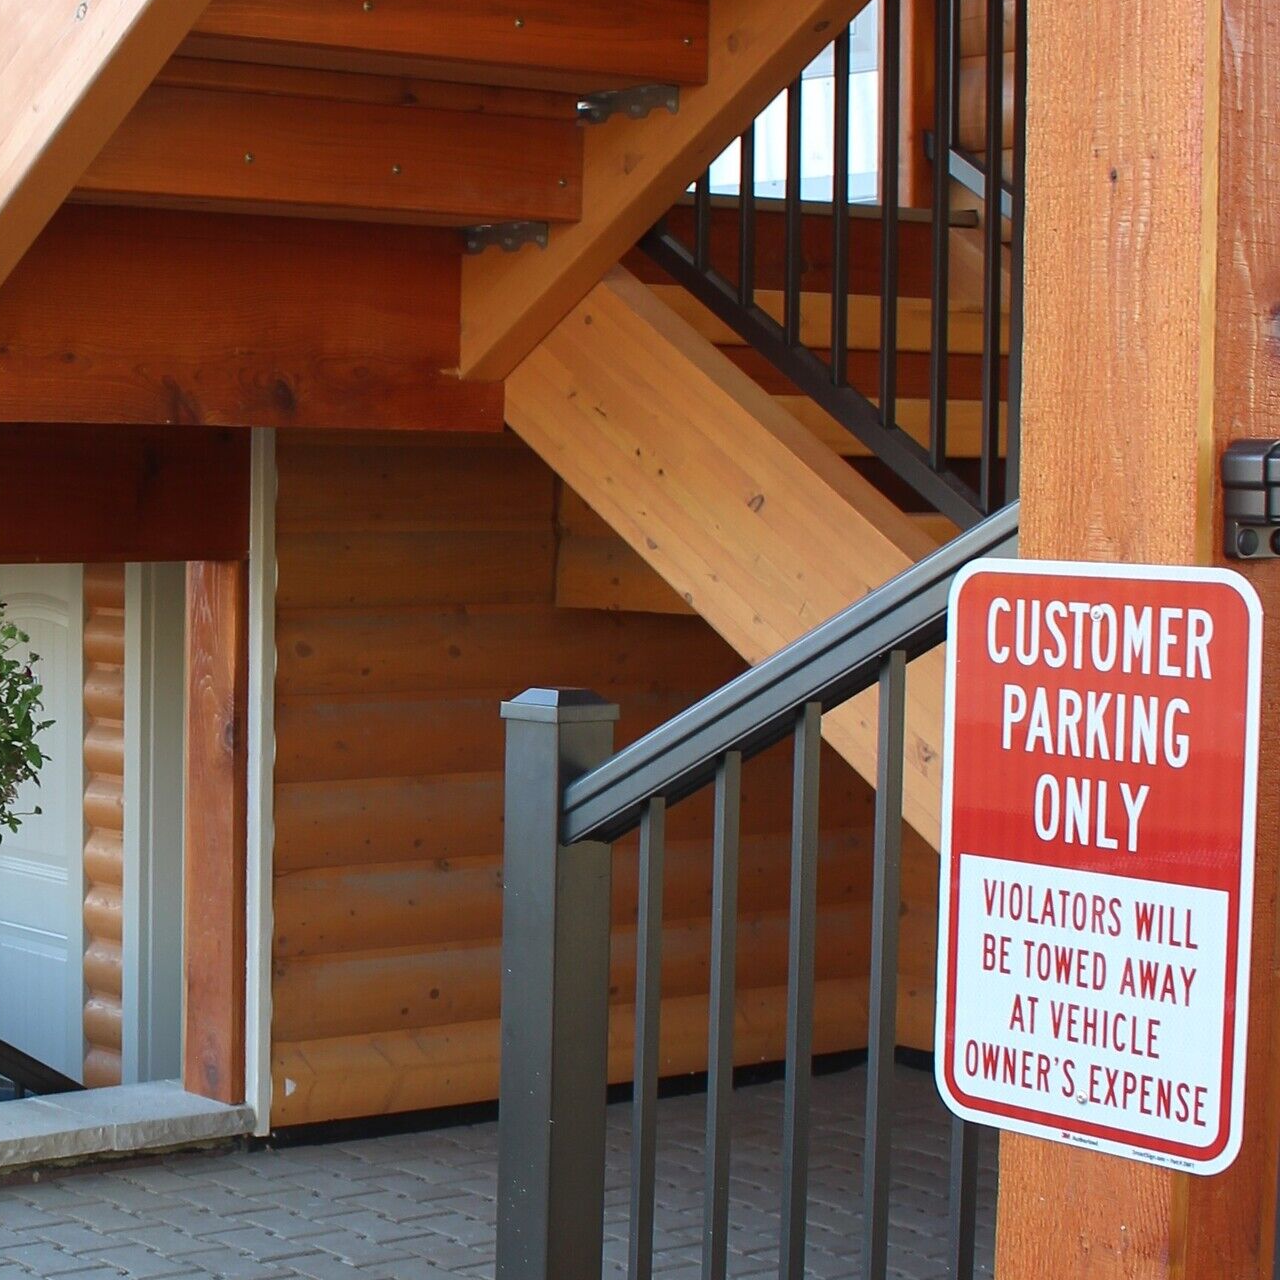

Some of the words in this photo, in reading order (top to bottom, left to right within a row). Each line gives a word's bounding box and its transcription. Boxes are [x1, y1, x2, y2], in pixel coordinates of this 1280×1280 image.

[987, 597, 1214, 680] CUSTOMER
[1002, 683, 1191, 768] PARKING
[1034, 773, 1150, 852] ONLY
[984, 878, 1122, 937] VIOLATORS
[1135, 901, 1198, 950] WILL
[982, 933, 1012, 974] BE
[1024, 939, 1107, 991] TOWED
[1120, 957, 1197, 1007] AWAY
[1009, 994, 1039, 1034] AT
[1050, 1000, 1160, 1059] VEHICLE
[965, 1039, 1076, 1098] OWNER'S
[1089, 1064, 1208, 1127] EXPENSE
